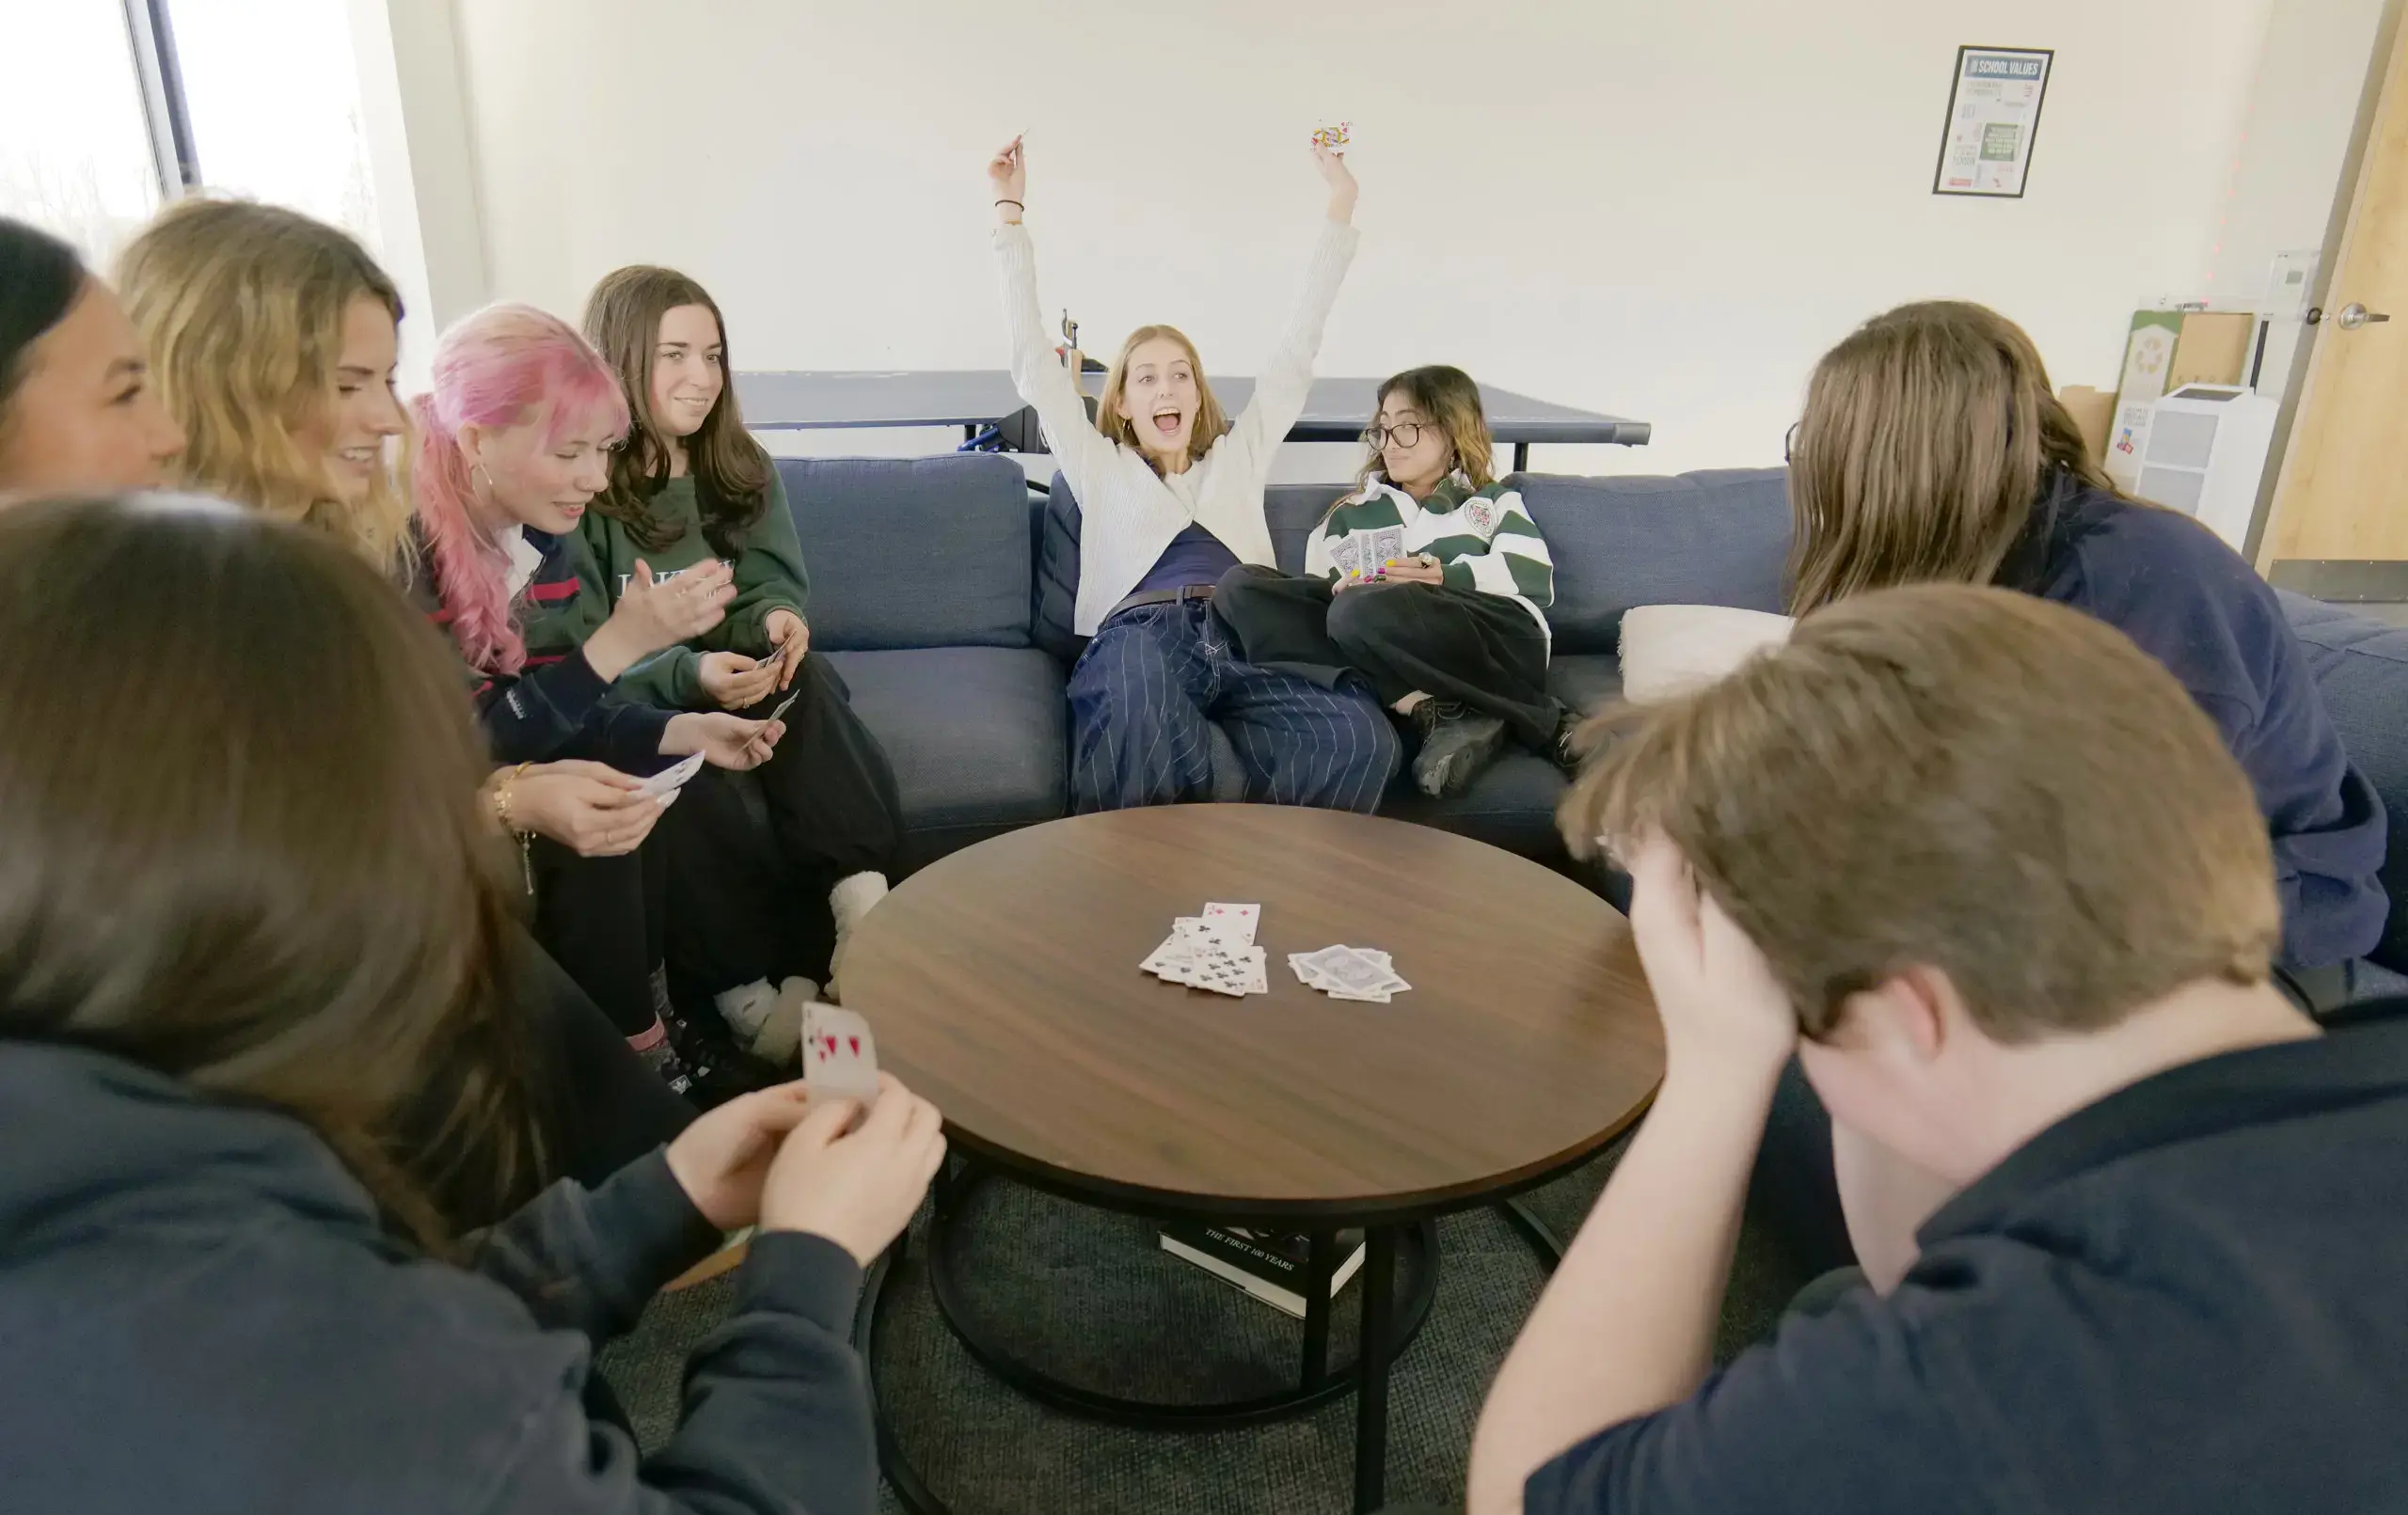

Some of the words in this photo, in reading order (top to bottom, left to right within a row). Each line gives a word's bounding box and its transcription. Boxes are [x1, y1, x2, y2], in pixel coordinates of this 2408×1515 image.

[1978, 59, 2008, 73] SCHOOL
[2009, 61, 2038, 76] VALUES
[1206, 1228, 1225, 1241] THE
[1224, 1238, 1251, 1252] FIRST
[1250, 1248, 1265, 1258] 100
[1264, 1254, 1294, 1271] YEARS
